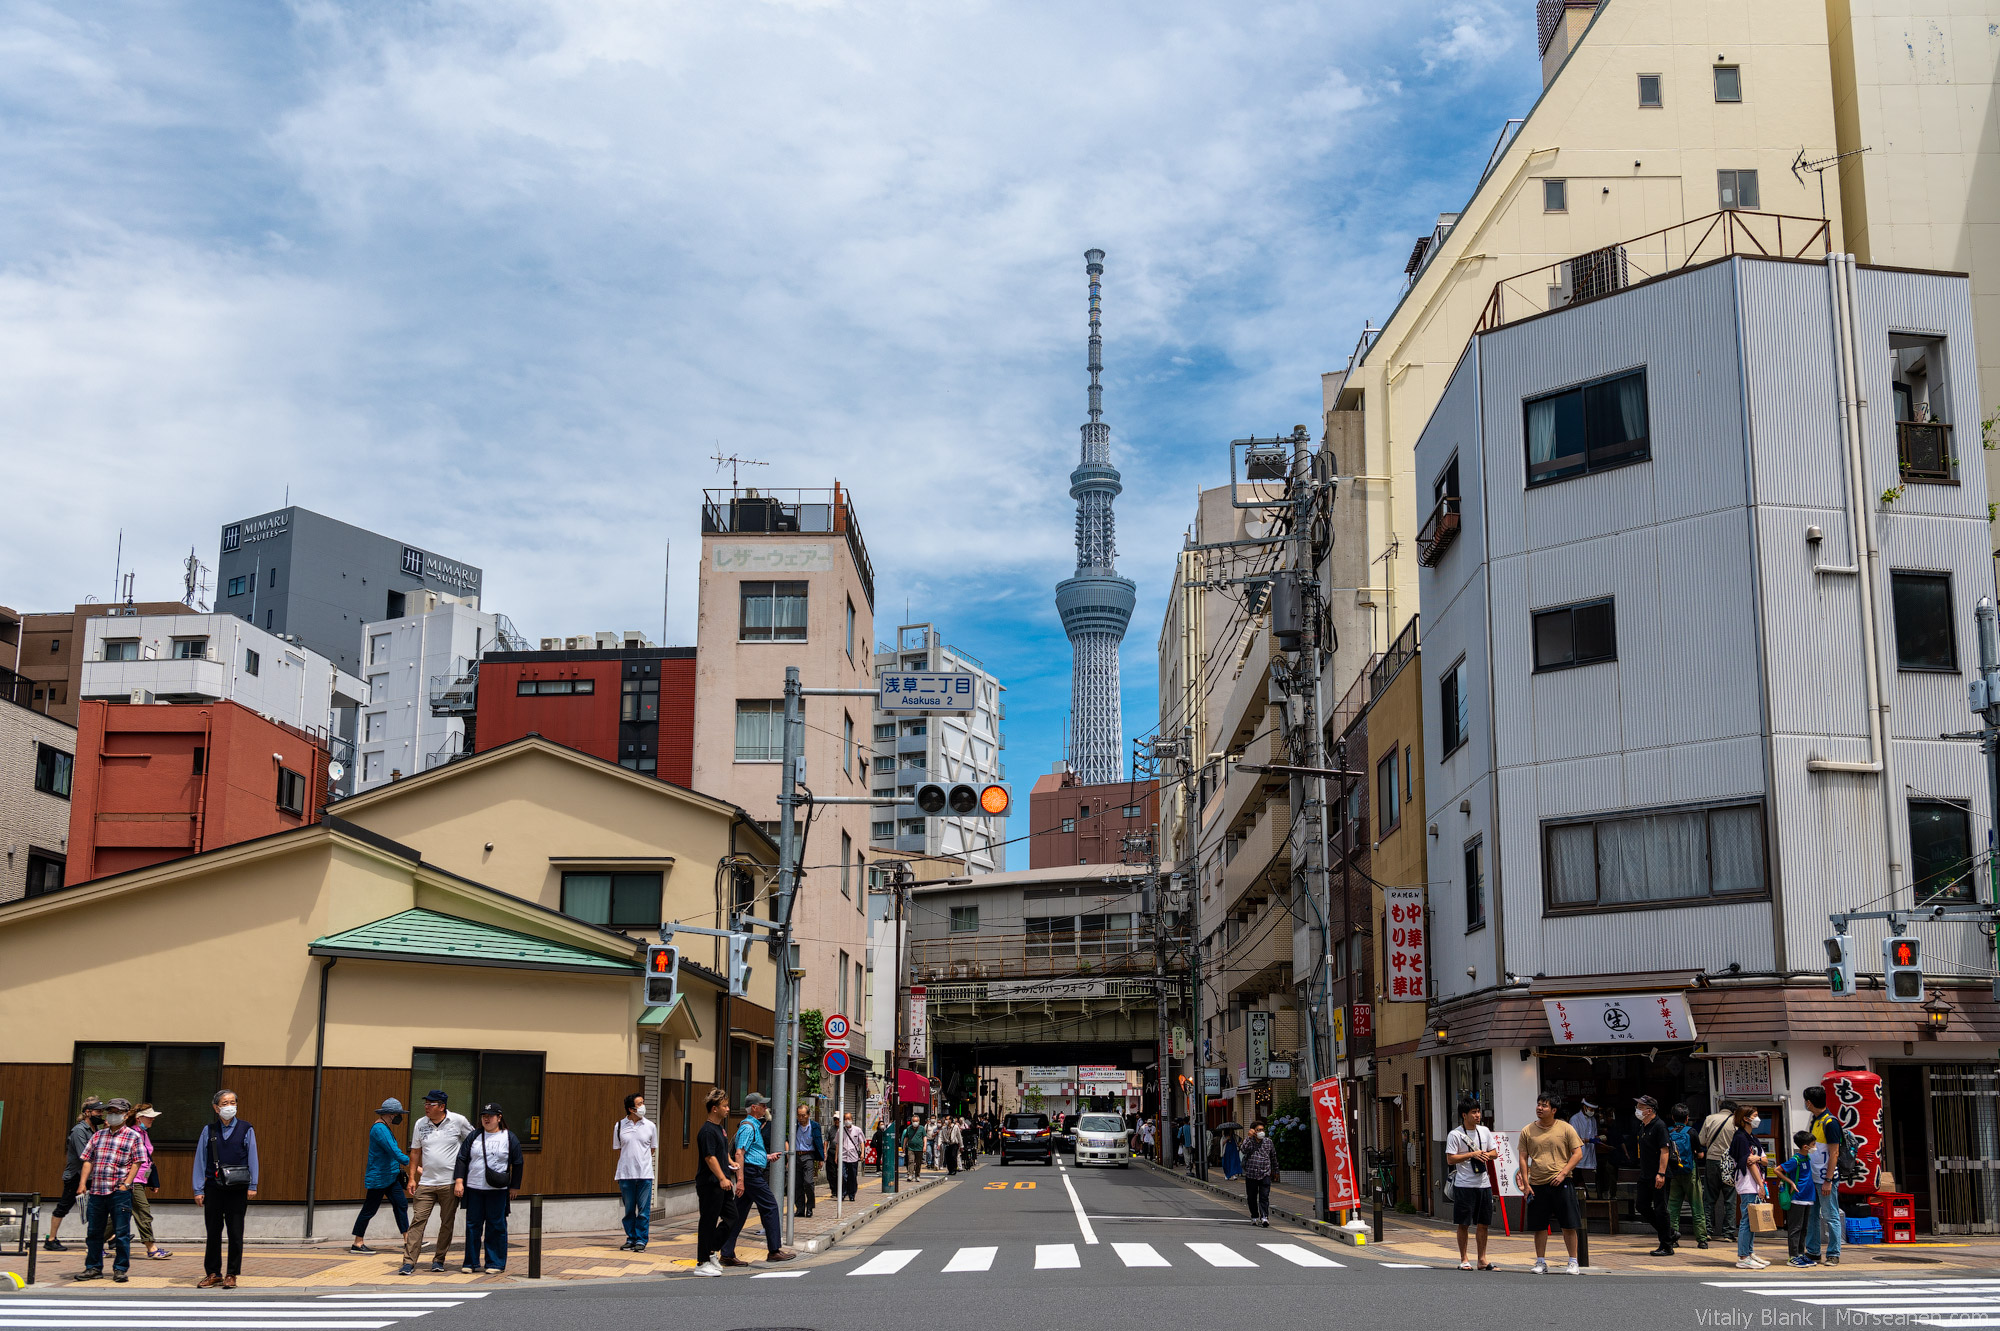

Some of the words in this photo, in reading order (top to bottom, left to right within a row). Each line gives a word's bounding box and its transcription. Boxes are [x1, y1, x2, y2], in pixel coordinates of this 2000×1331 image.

[243, 513, 289, 535] MIMARU
[252, 529, 279, 543] SUITES
[716, 549, 831, 567] レザーウェアー
[425, 557, 479, 583] MIMARU
[436, 572, 467, 589] SUITES
[884, 677, 970, 694] 浅草二丁目
[901, 695, 941, 705] Asakusa
[946, 696, 953, 706] 2
[1391, 891, 1420, 899] RAMEN
[1391, 903, 1408, 998] もり中華
[1406, 902, 1424, 997] 中華そば
[1354, 1007, 1370, 1016] 200
[1656, 997, 1678, 1039] 中華そば
[829, 1021, 845, 1033] 30
[1555, 1001, 1575, 1042] もり中華
[1252, 1039, 1263, 1076] からあげ
[983, 1181, 1037, 1190] 30
